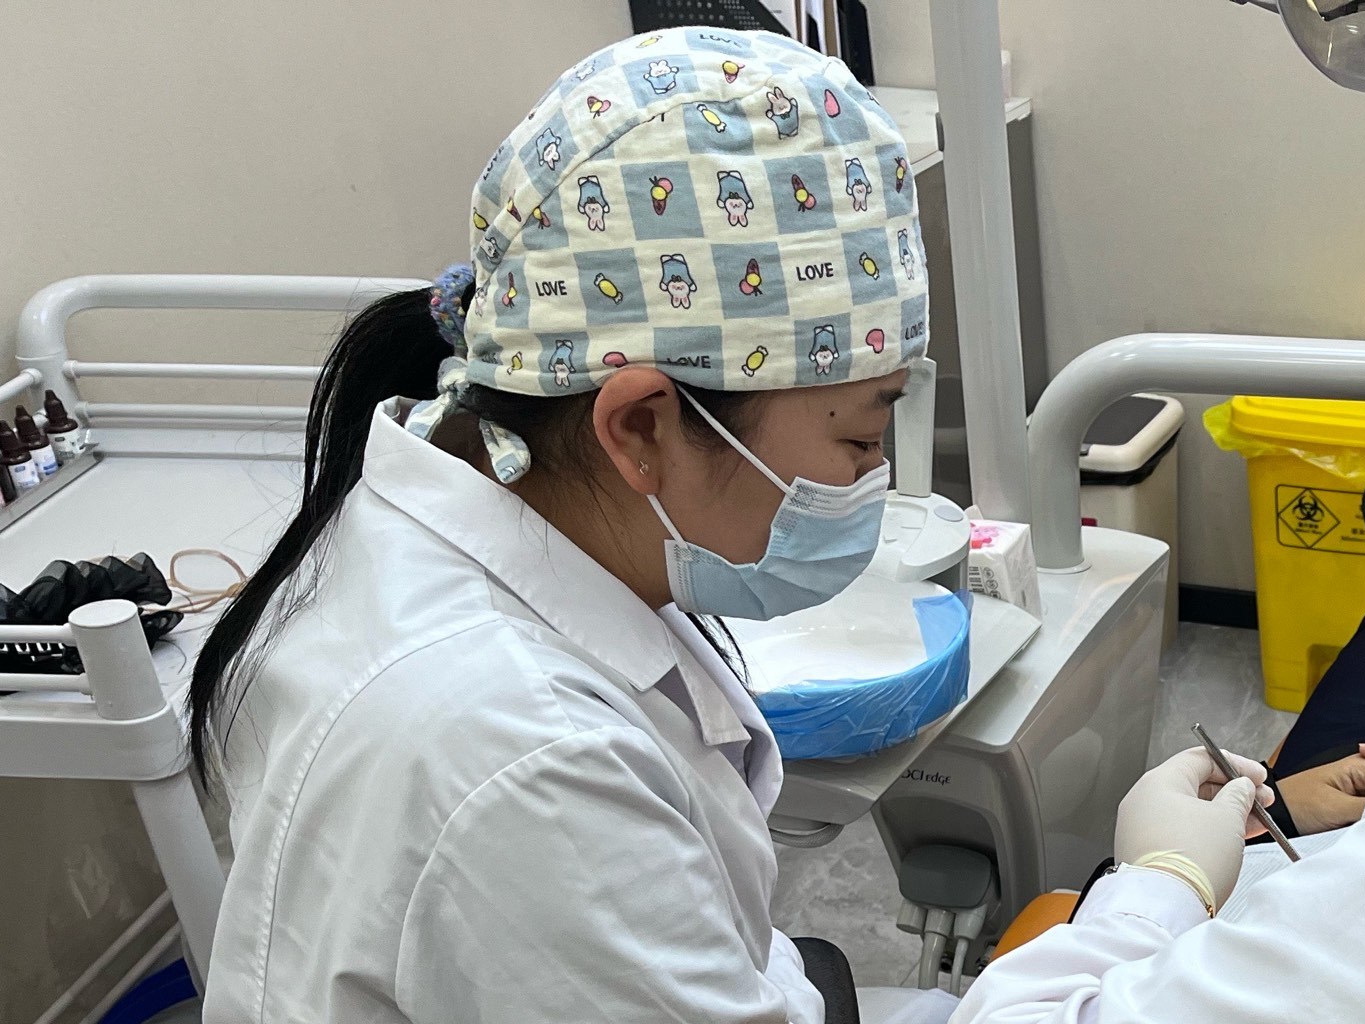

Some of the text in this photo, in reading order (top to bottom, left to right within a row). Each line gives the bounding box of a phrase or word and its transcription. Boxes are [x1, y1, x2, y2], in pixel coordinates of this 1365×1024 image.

[795, 262, 834, 281] LOVE
[535, 280, 568, 297] LOVE
[666, 355, 712, 369] LOVE
